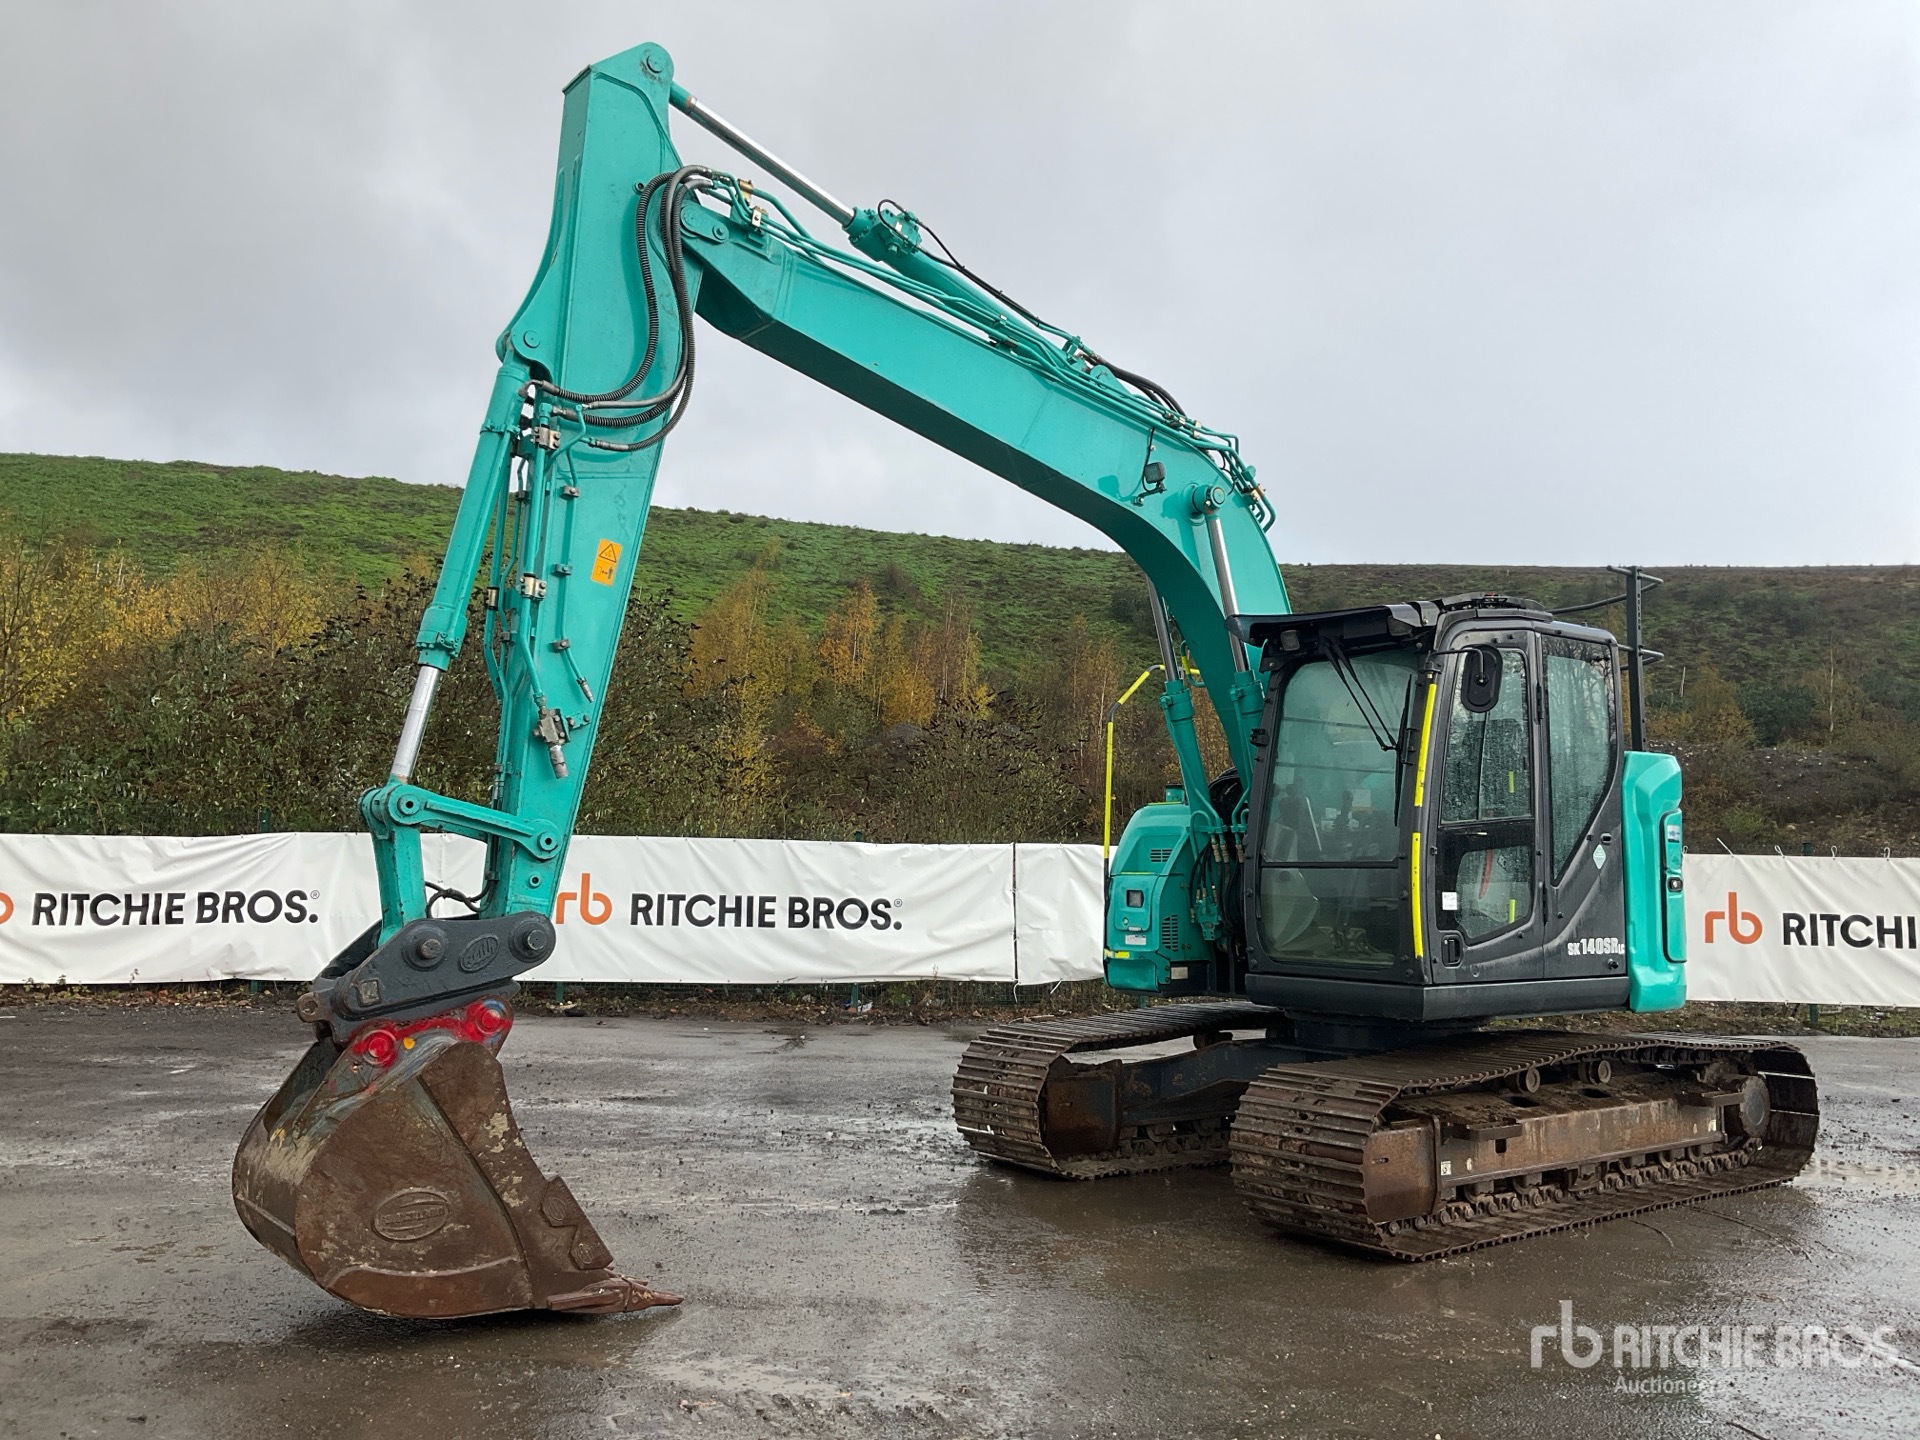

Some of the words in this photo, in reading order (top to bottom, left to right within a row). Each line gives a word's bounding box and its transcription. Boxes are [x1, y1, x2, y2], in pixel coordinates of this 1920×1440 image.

[32, 892, 186, 926] RITCHIE
[556, 873, 612, 925] rb
[630, 893, 777, 928] RITCHIE
[1704, 892, 1763, 944] rb
[1782, 912, 1917, 949] RITCHI
